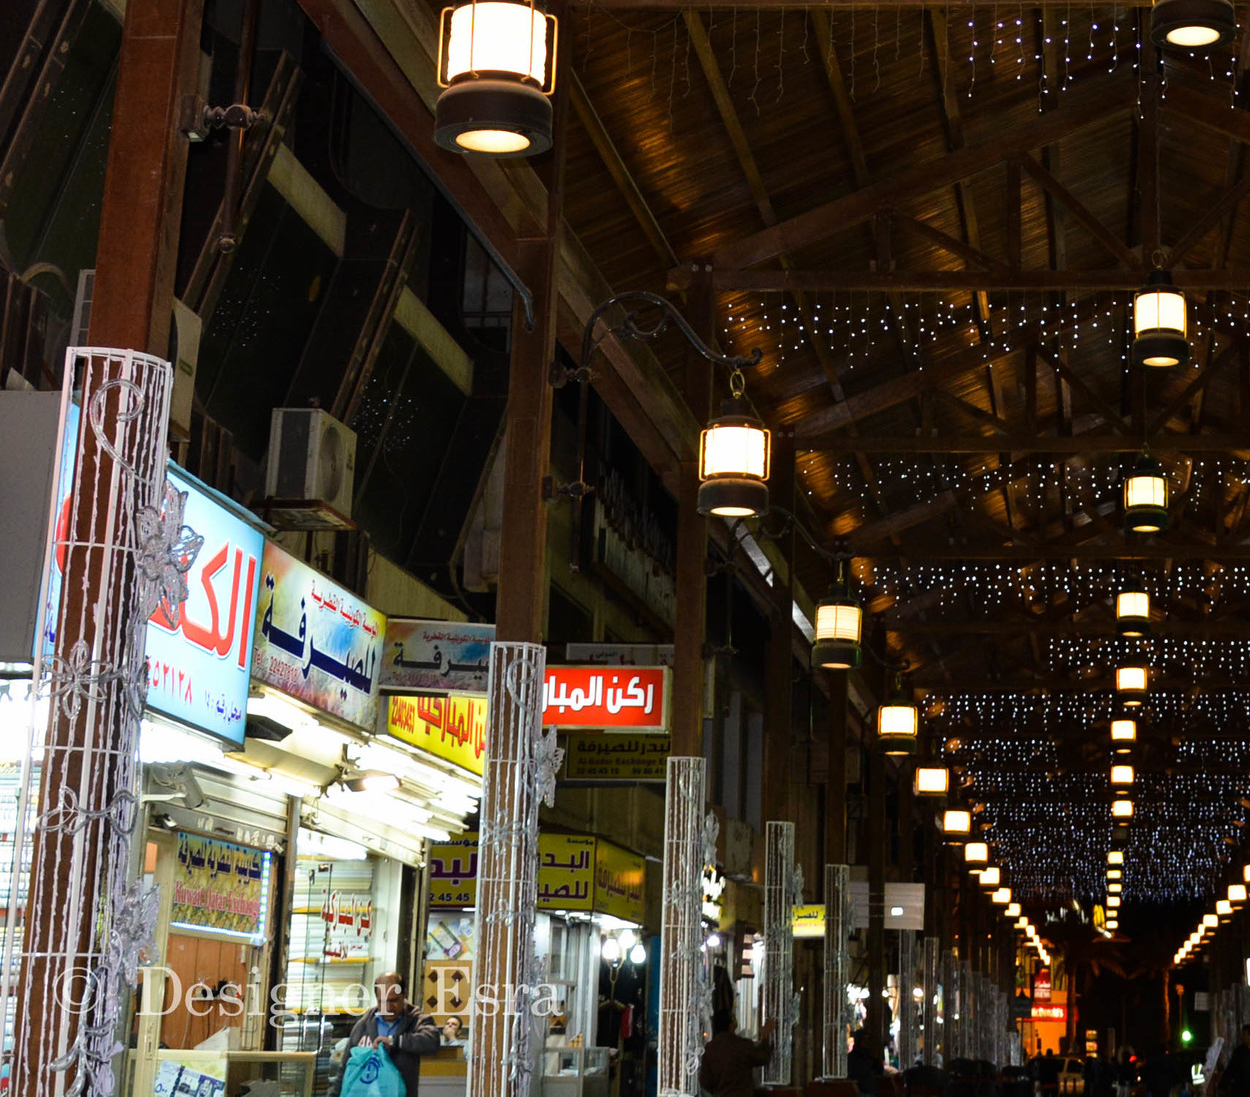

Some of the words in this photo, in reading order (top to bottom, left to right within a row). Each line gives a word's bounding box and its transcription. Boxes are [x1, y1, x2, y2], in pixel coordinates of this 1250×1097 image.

[262, 574, 376, 701] للصيرفة
[542, 675, 603, 714] المبار
[607, 675, 654, 714] ركن
[438, 893, 452, 902] 45
[456, 893, 470, 902] 45
